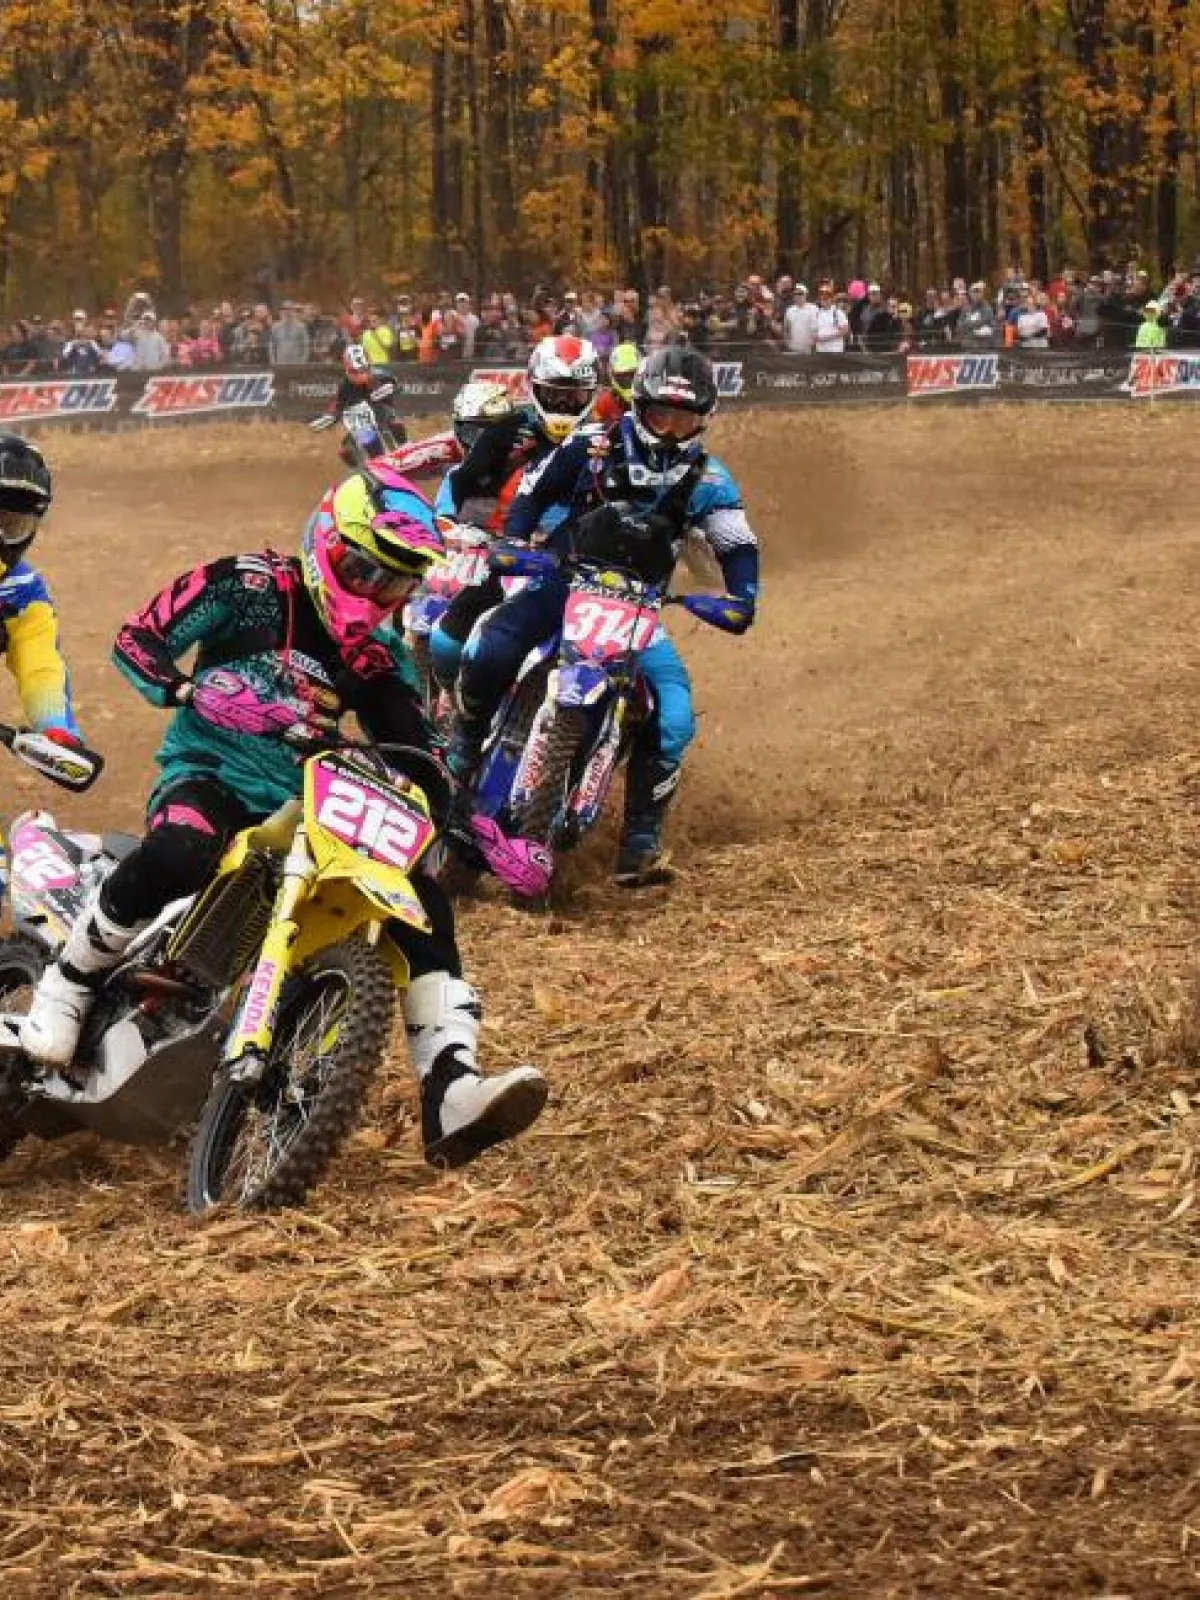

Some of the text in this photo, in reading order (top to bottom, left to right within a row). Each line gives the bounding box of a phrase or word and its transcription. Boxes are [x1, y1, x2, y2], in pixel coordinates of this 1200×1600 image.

[146, 376, 271, 414] AMSOIL
[907, 357, 997, 395] AMSOIL
[572, 601, 652, 650] 314
[317, 778, 419, 868] 212
[238, 959, 276, 1035] KENDA
